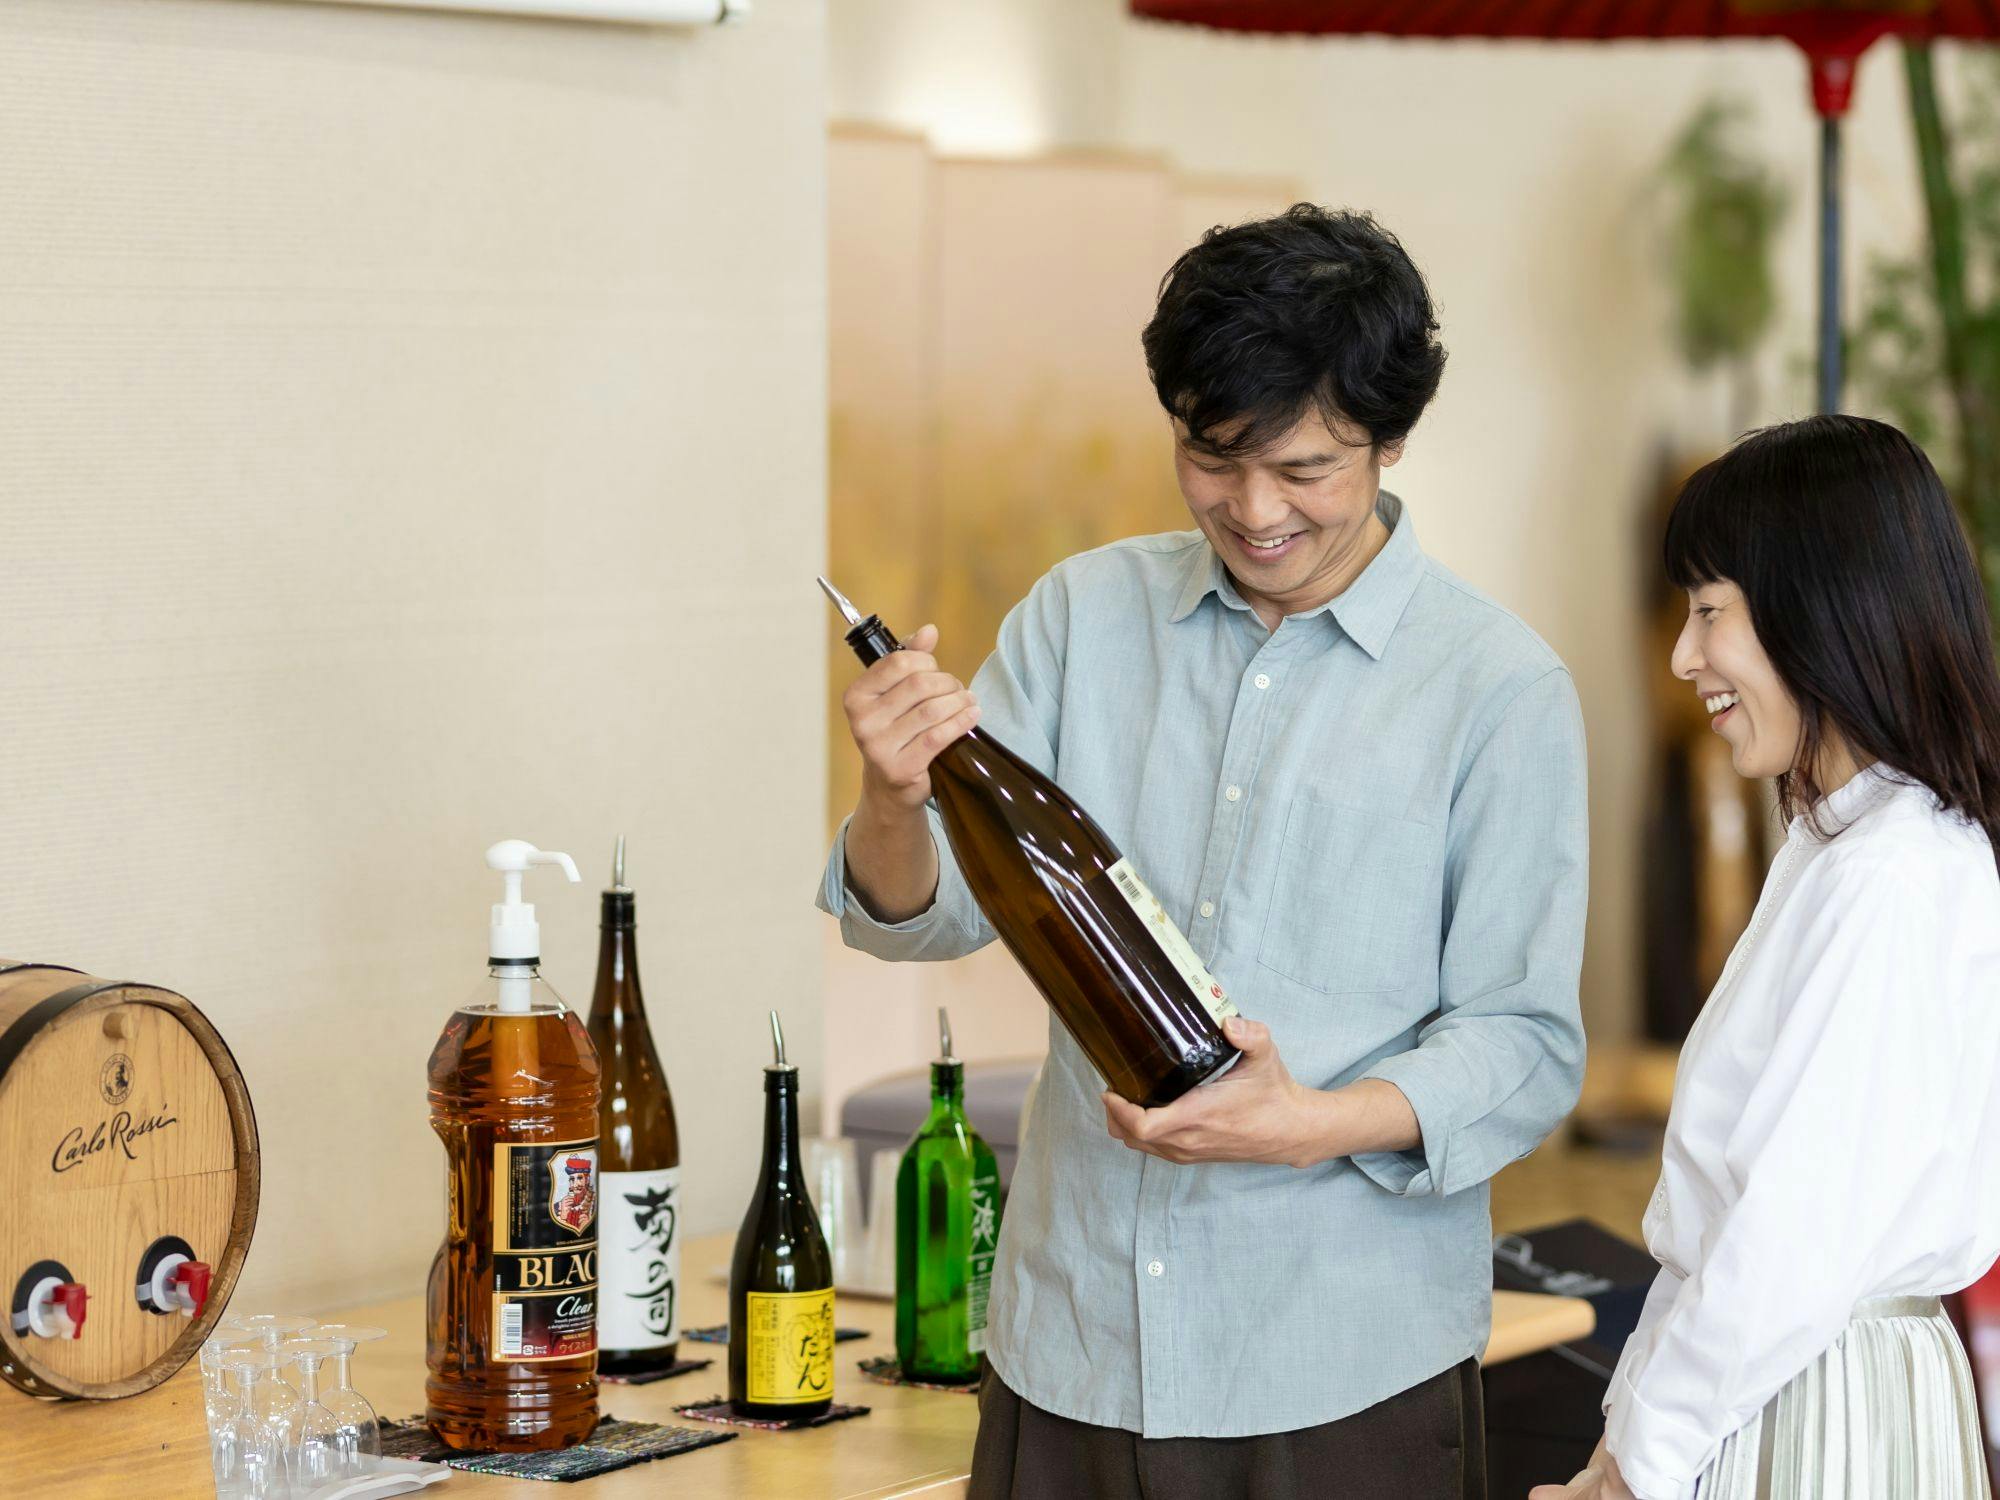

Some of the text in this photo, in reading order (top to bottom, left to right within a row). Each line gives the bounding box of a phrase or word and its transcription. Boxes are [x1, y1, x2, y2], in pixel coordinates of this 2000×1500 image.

[52, 1103, 177, 1173] Carlo Rossi
[556, 1296, 594, 1317] Clear
